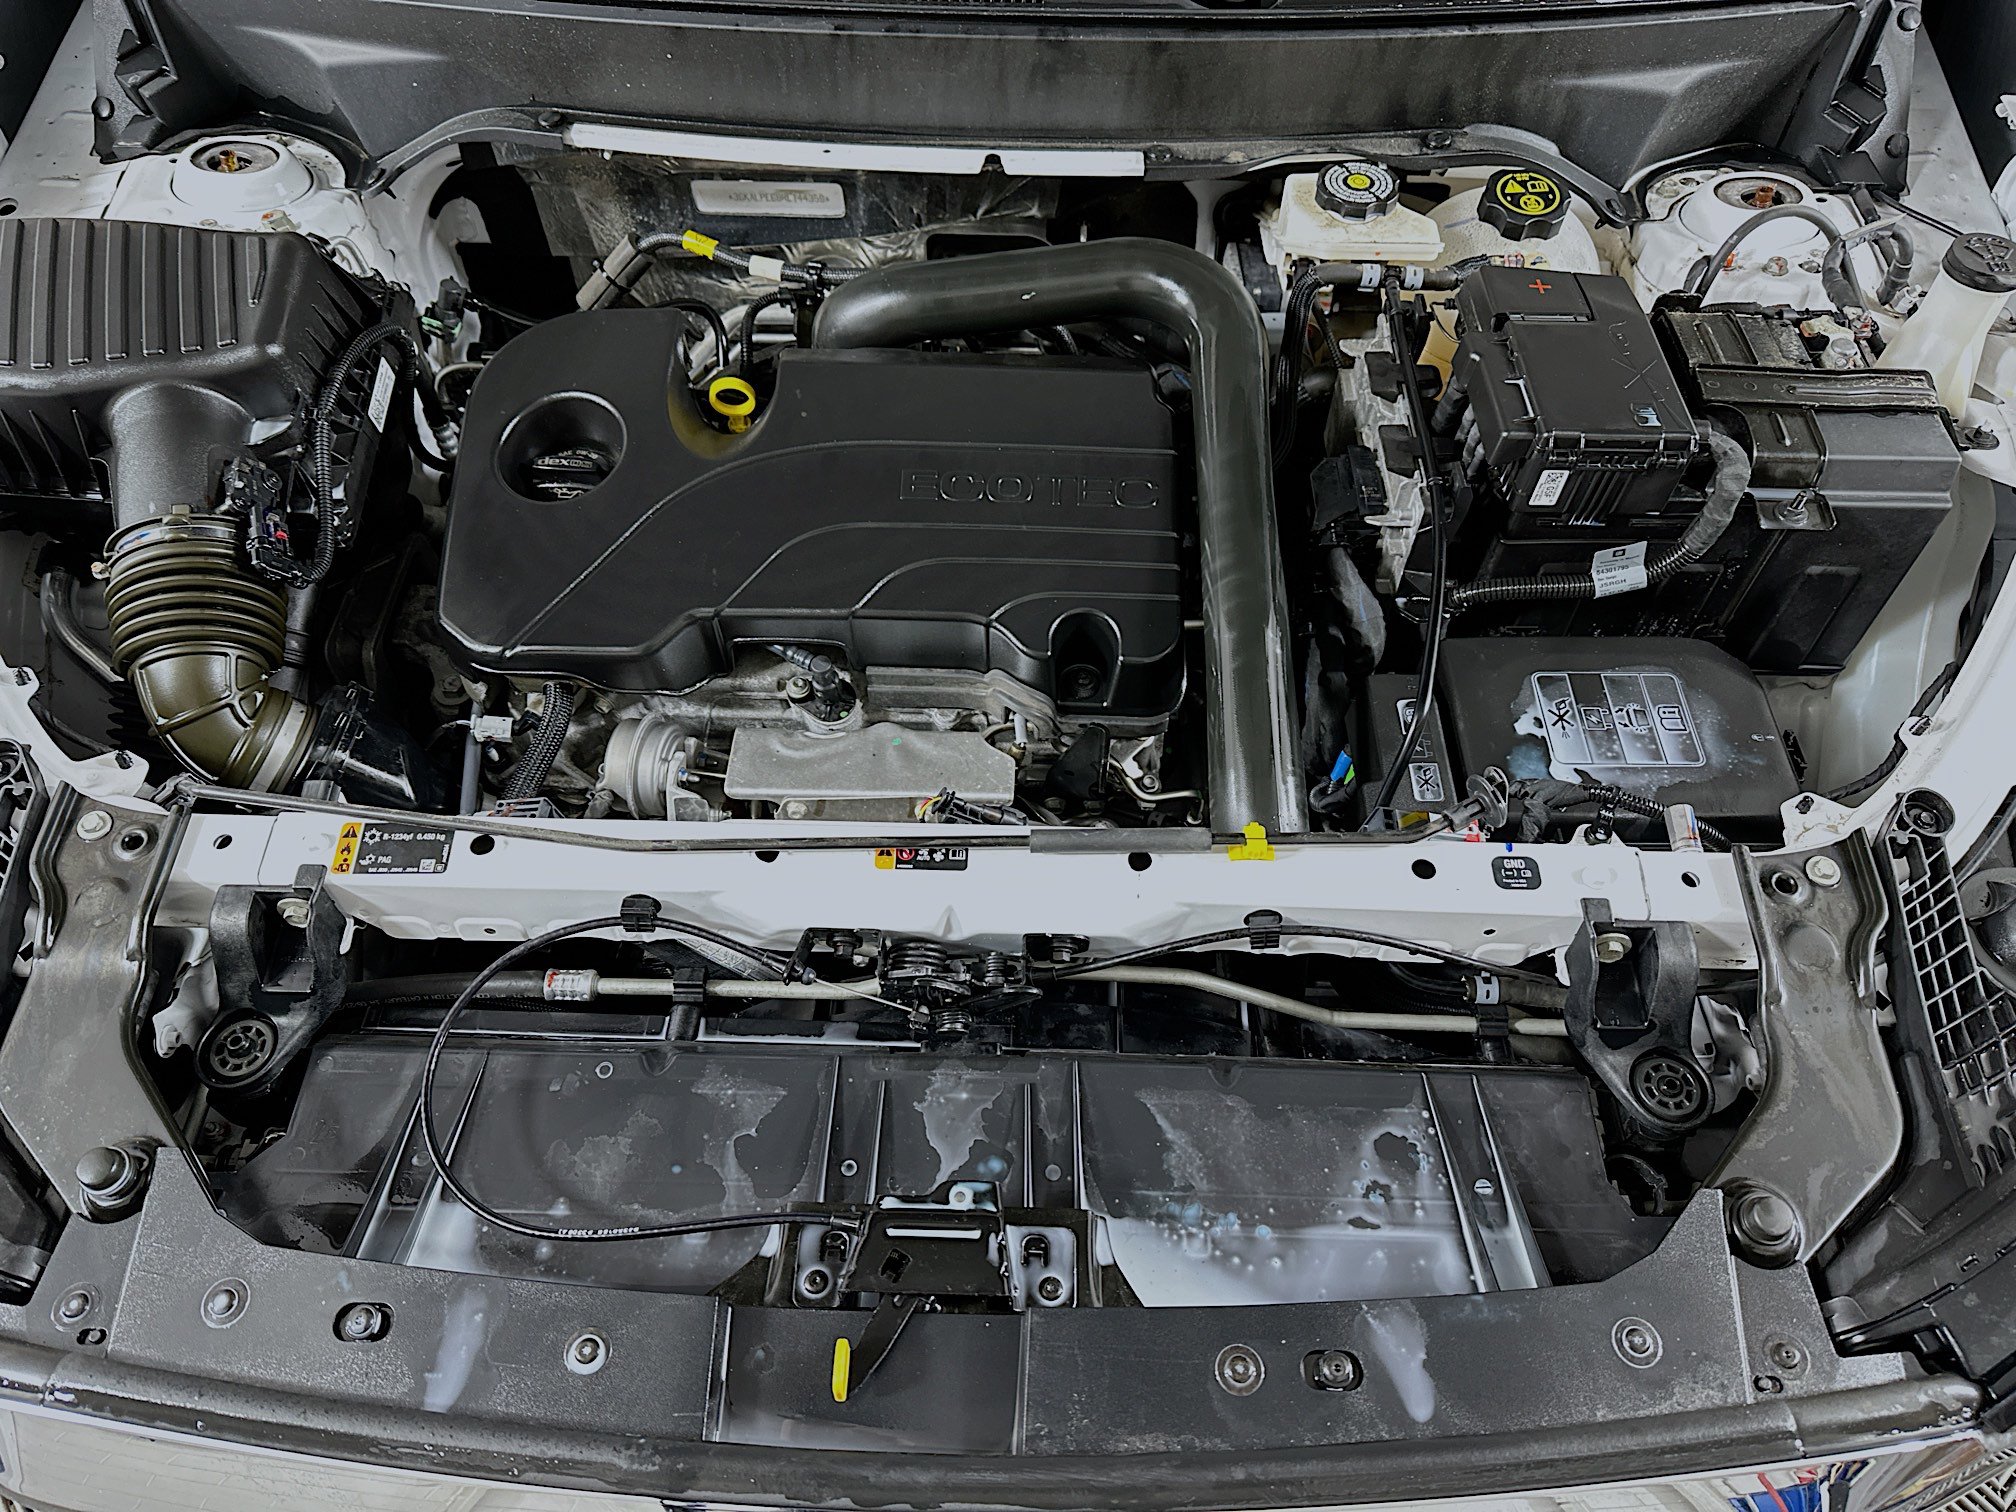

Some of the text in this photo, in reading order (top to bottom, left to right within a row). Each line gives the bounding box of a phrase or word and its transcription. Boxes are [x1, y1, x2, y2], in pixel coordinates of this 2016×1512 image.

[899, 468, 1159, 509] ECOTEC
[382, 832, 413, 842] R-1234yf
[436, 833, 446, 842] kg
[377, 855, 392, 864] PAG
[1502, 858, 1526, 869] GND
